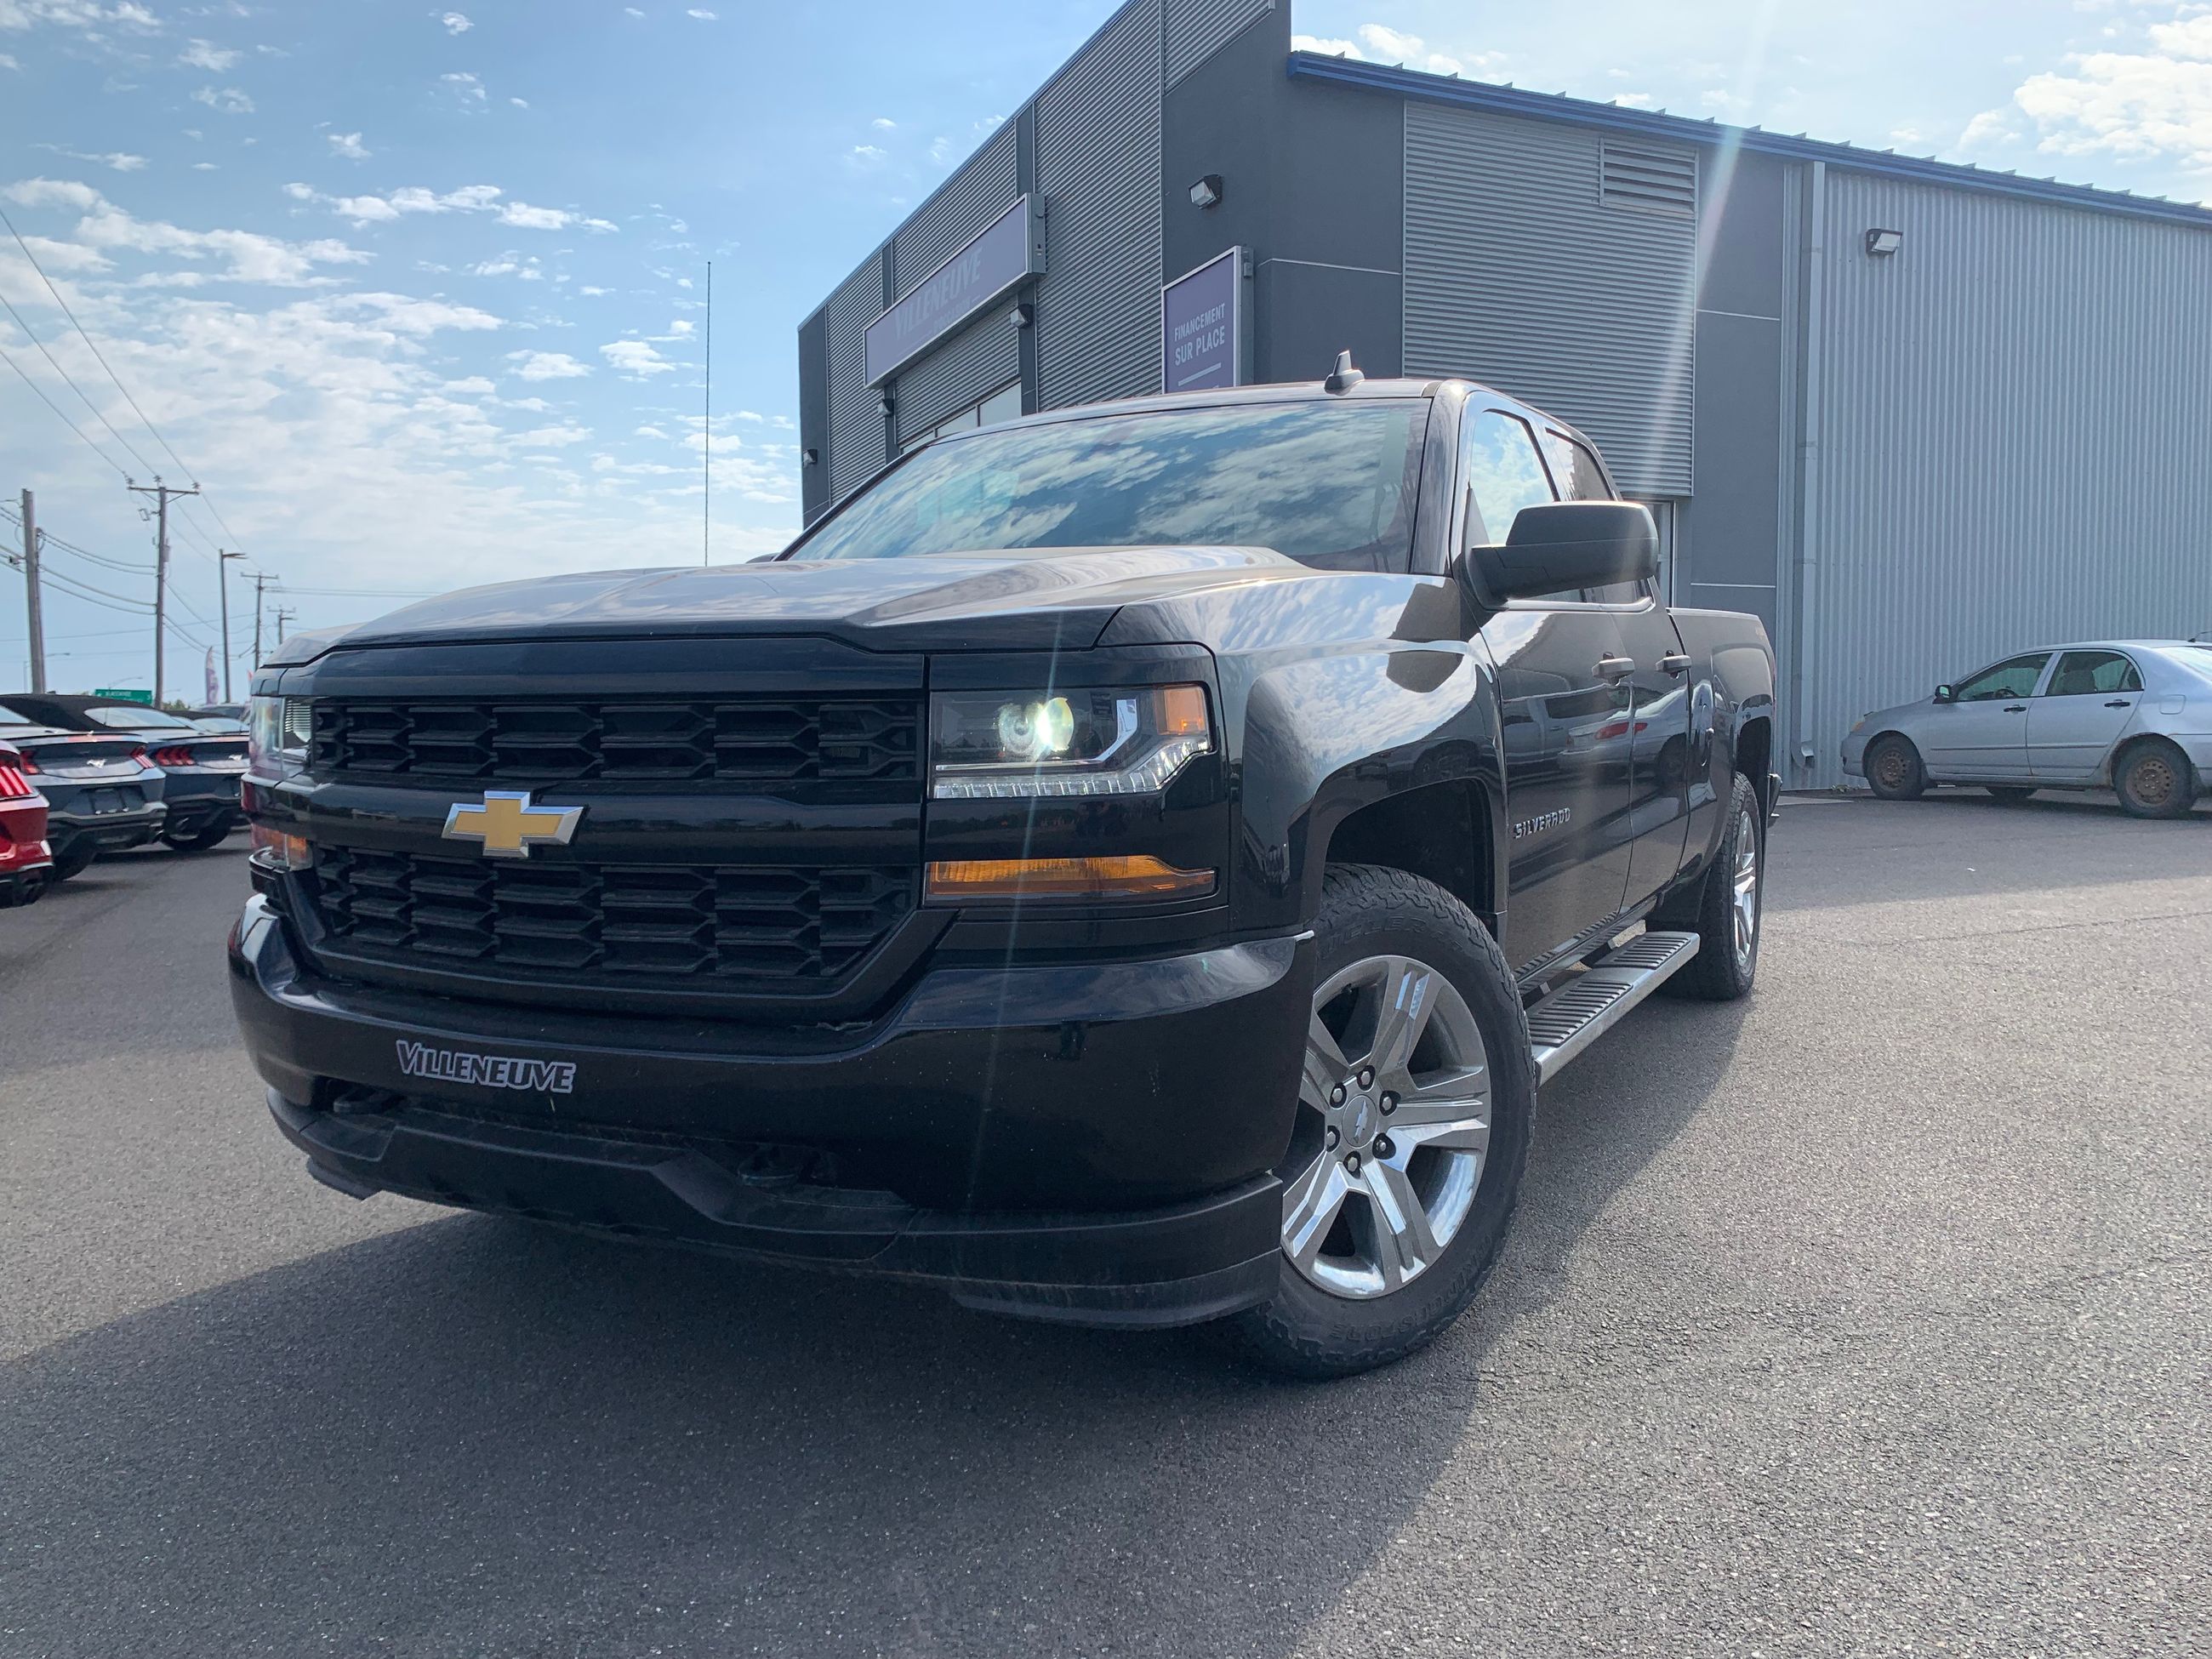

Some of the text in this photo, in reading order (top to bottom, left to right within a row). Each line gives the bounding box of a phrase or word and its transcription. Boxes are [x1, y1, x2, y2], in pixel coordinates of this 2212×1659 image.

[894, 246, 983, 340] VILLENEUVE
[1174, 303, 1225, 342] FINANCEMENT
[1175, 325, 1225, 366] SUR PLACE
[1514, 807, 1571, 839] SILVERADO
[396, 1040, 577, 1093] VILLENEUVE
